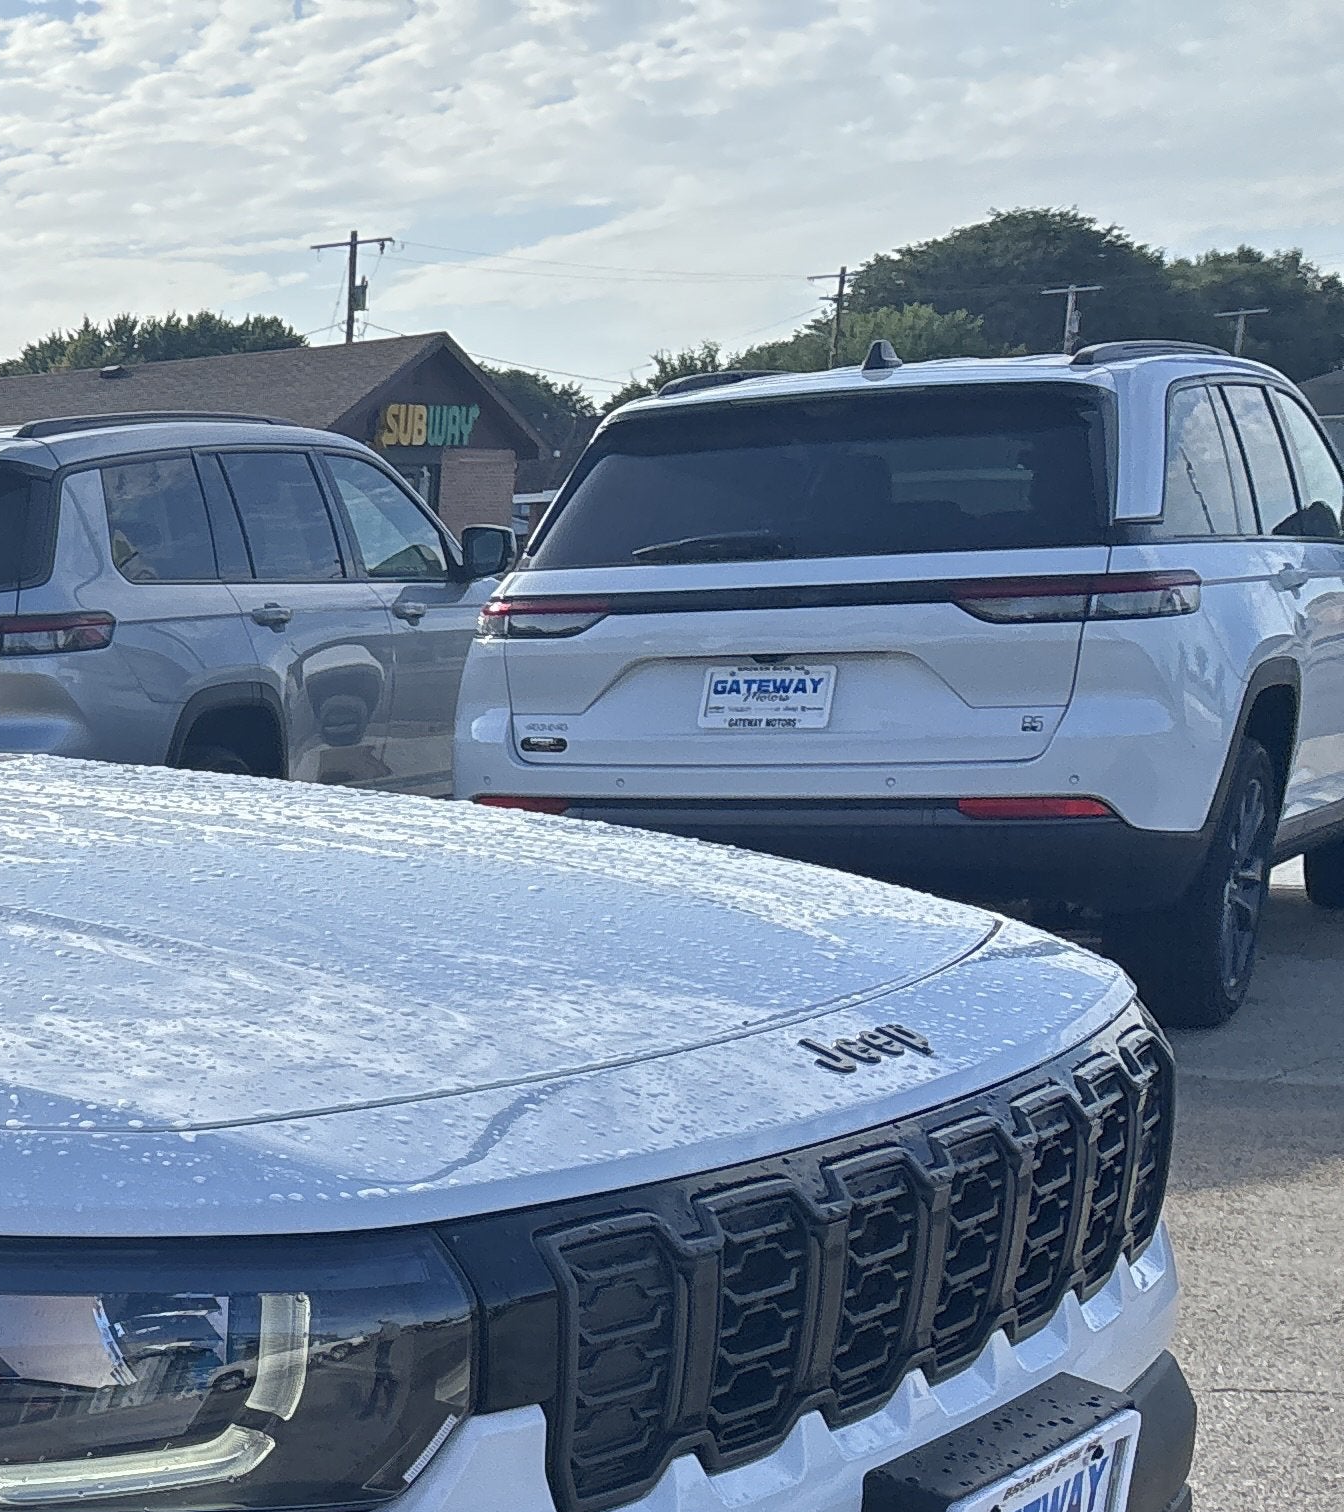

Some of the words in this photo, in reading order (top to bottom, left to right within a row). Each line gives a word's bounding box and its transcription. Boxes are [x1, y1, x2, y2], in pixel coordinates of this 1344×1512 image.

[382, 403, 480, 448] SUBWAY
[713, 678, 825, 695] GATEWAY
[728, 718, 763, 728] GATEWAY
[765, 717, 797, 728] MOTORS
[798, 1023, 934, 1073] Jeep
